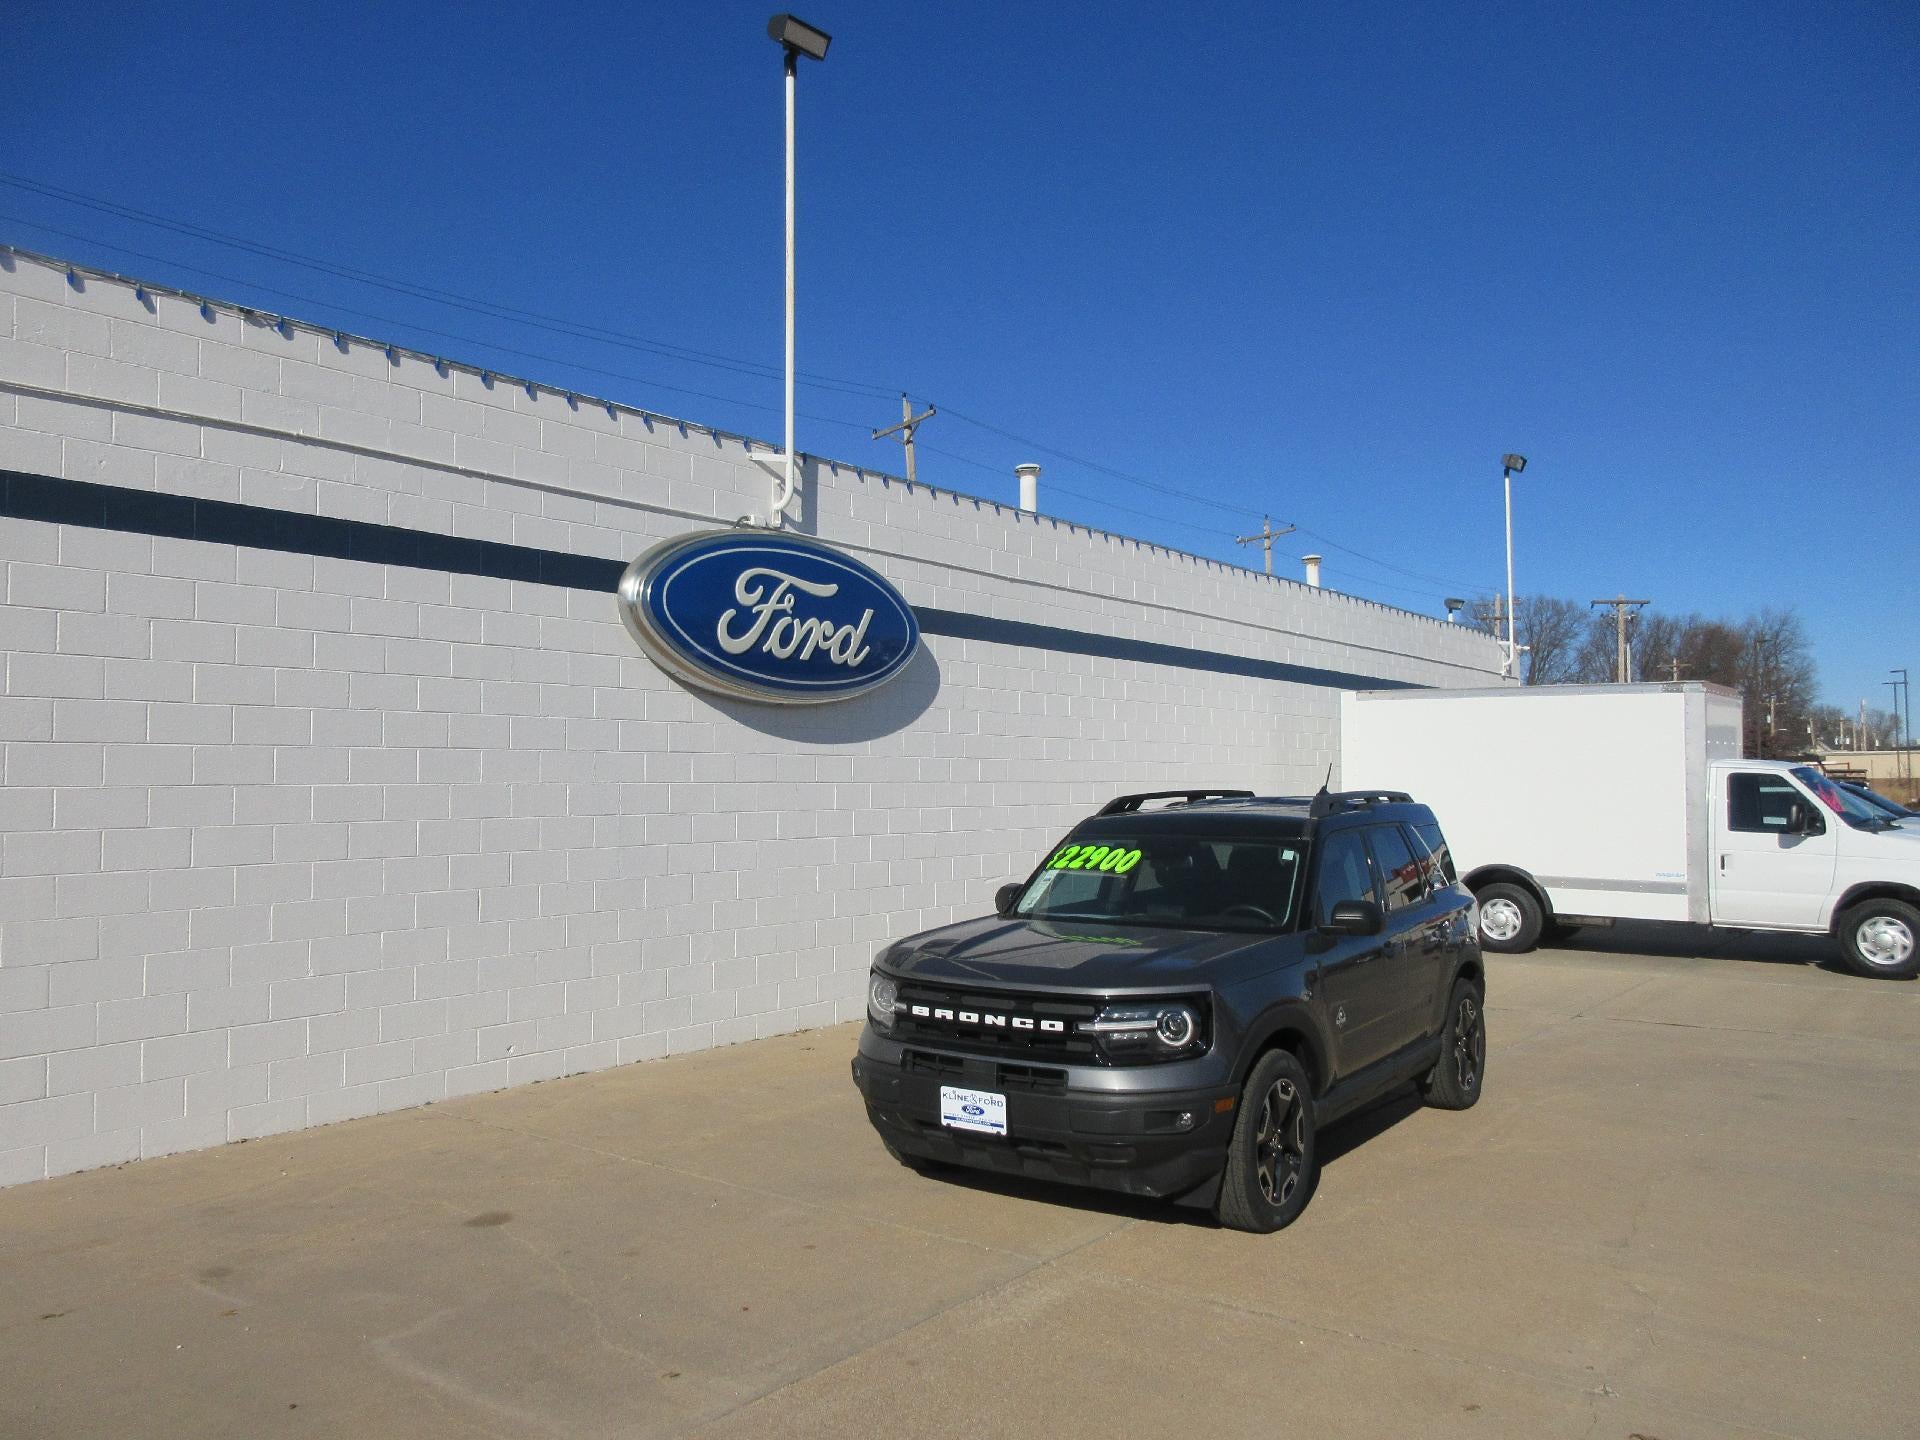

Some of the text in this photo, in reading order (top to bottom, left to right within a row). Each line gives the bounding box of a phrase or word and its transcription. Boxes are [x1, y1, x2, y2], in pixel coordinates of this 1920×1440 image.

[717, 567, 874, 667] Ford
[912, 1005, 1064, 1032] BRONCO
[978, 1097, 1004, 1108] FORD
